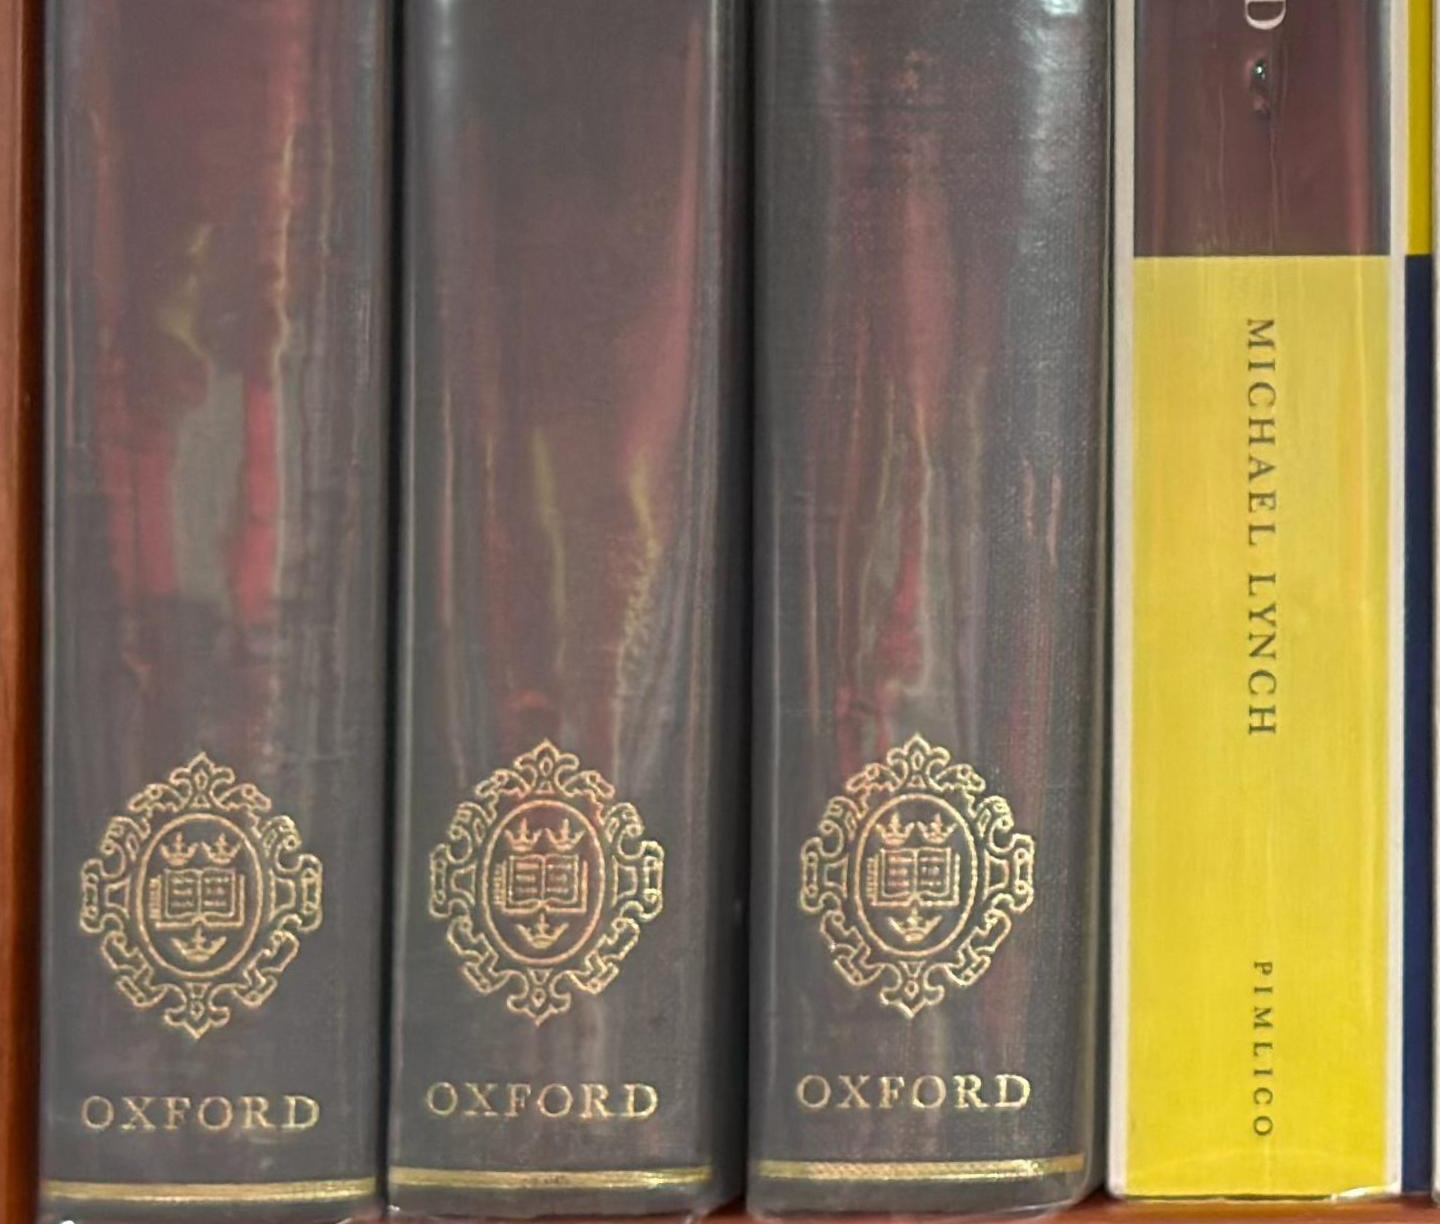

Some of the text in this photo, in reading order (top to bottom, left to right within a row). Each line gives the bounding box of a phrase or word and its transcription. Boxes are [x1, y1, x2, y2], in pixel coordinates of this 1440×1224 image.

[1245, 317, 1279, 738] MICHAEL LYNCH
[1251, 960, 1276, 1138] PIMLICO
[425, 1079, 661, 1119] OXFORD
[798, 1072, 1032, 1112] OXFORD
[80, 1093, 322, 1133] OXFORD
